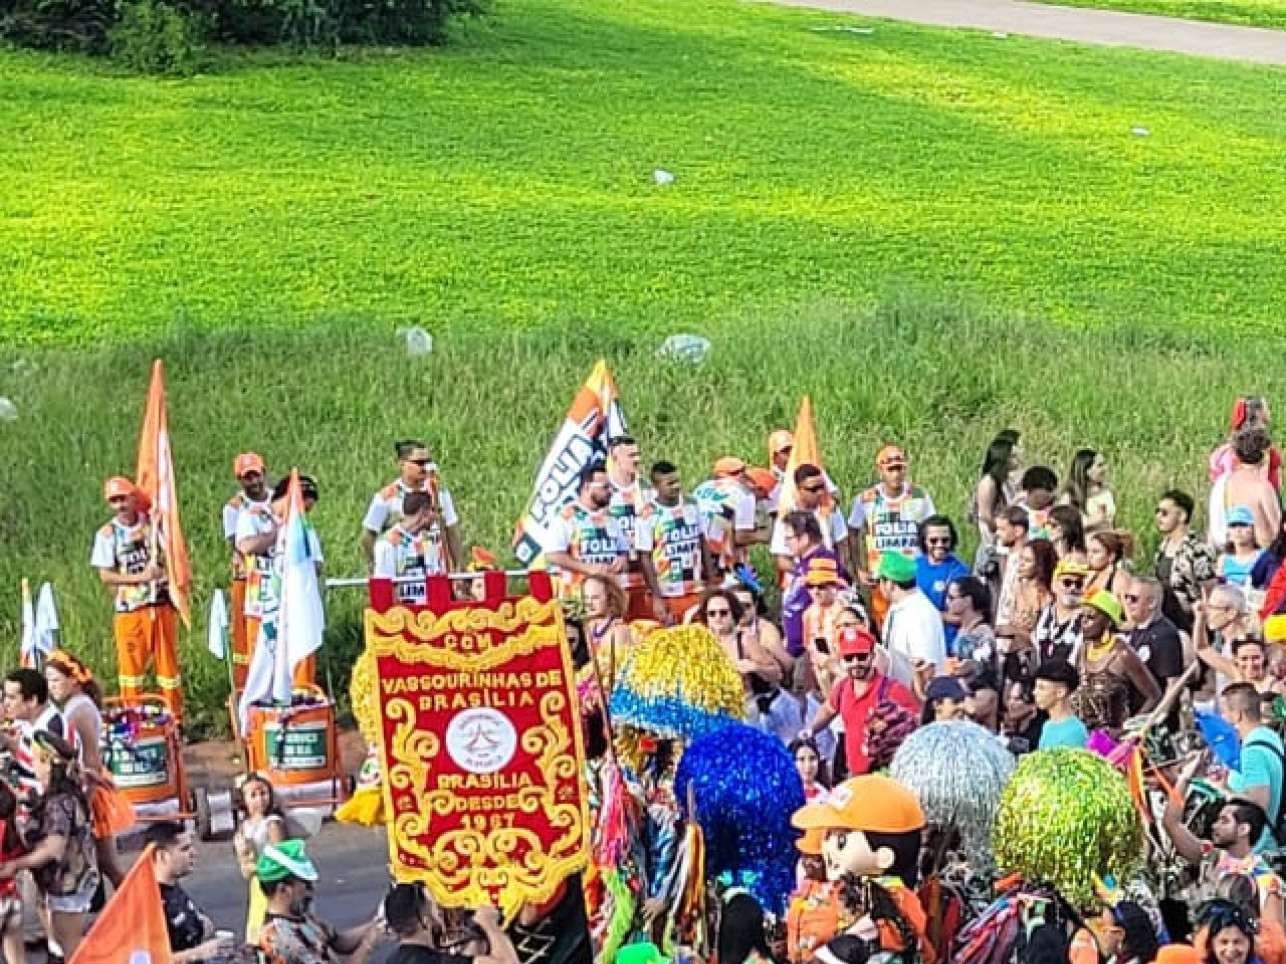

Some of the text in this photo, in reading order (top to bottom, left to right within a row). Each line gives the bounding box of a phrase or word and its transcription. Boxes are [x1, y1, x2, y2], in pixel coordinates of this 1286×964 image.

[382, 669, 562, 694] VASSOURINHAS DE
[419, 687, 534, 711] BRASÍLIA
[454, 796, 519, 811] DESDE
